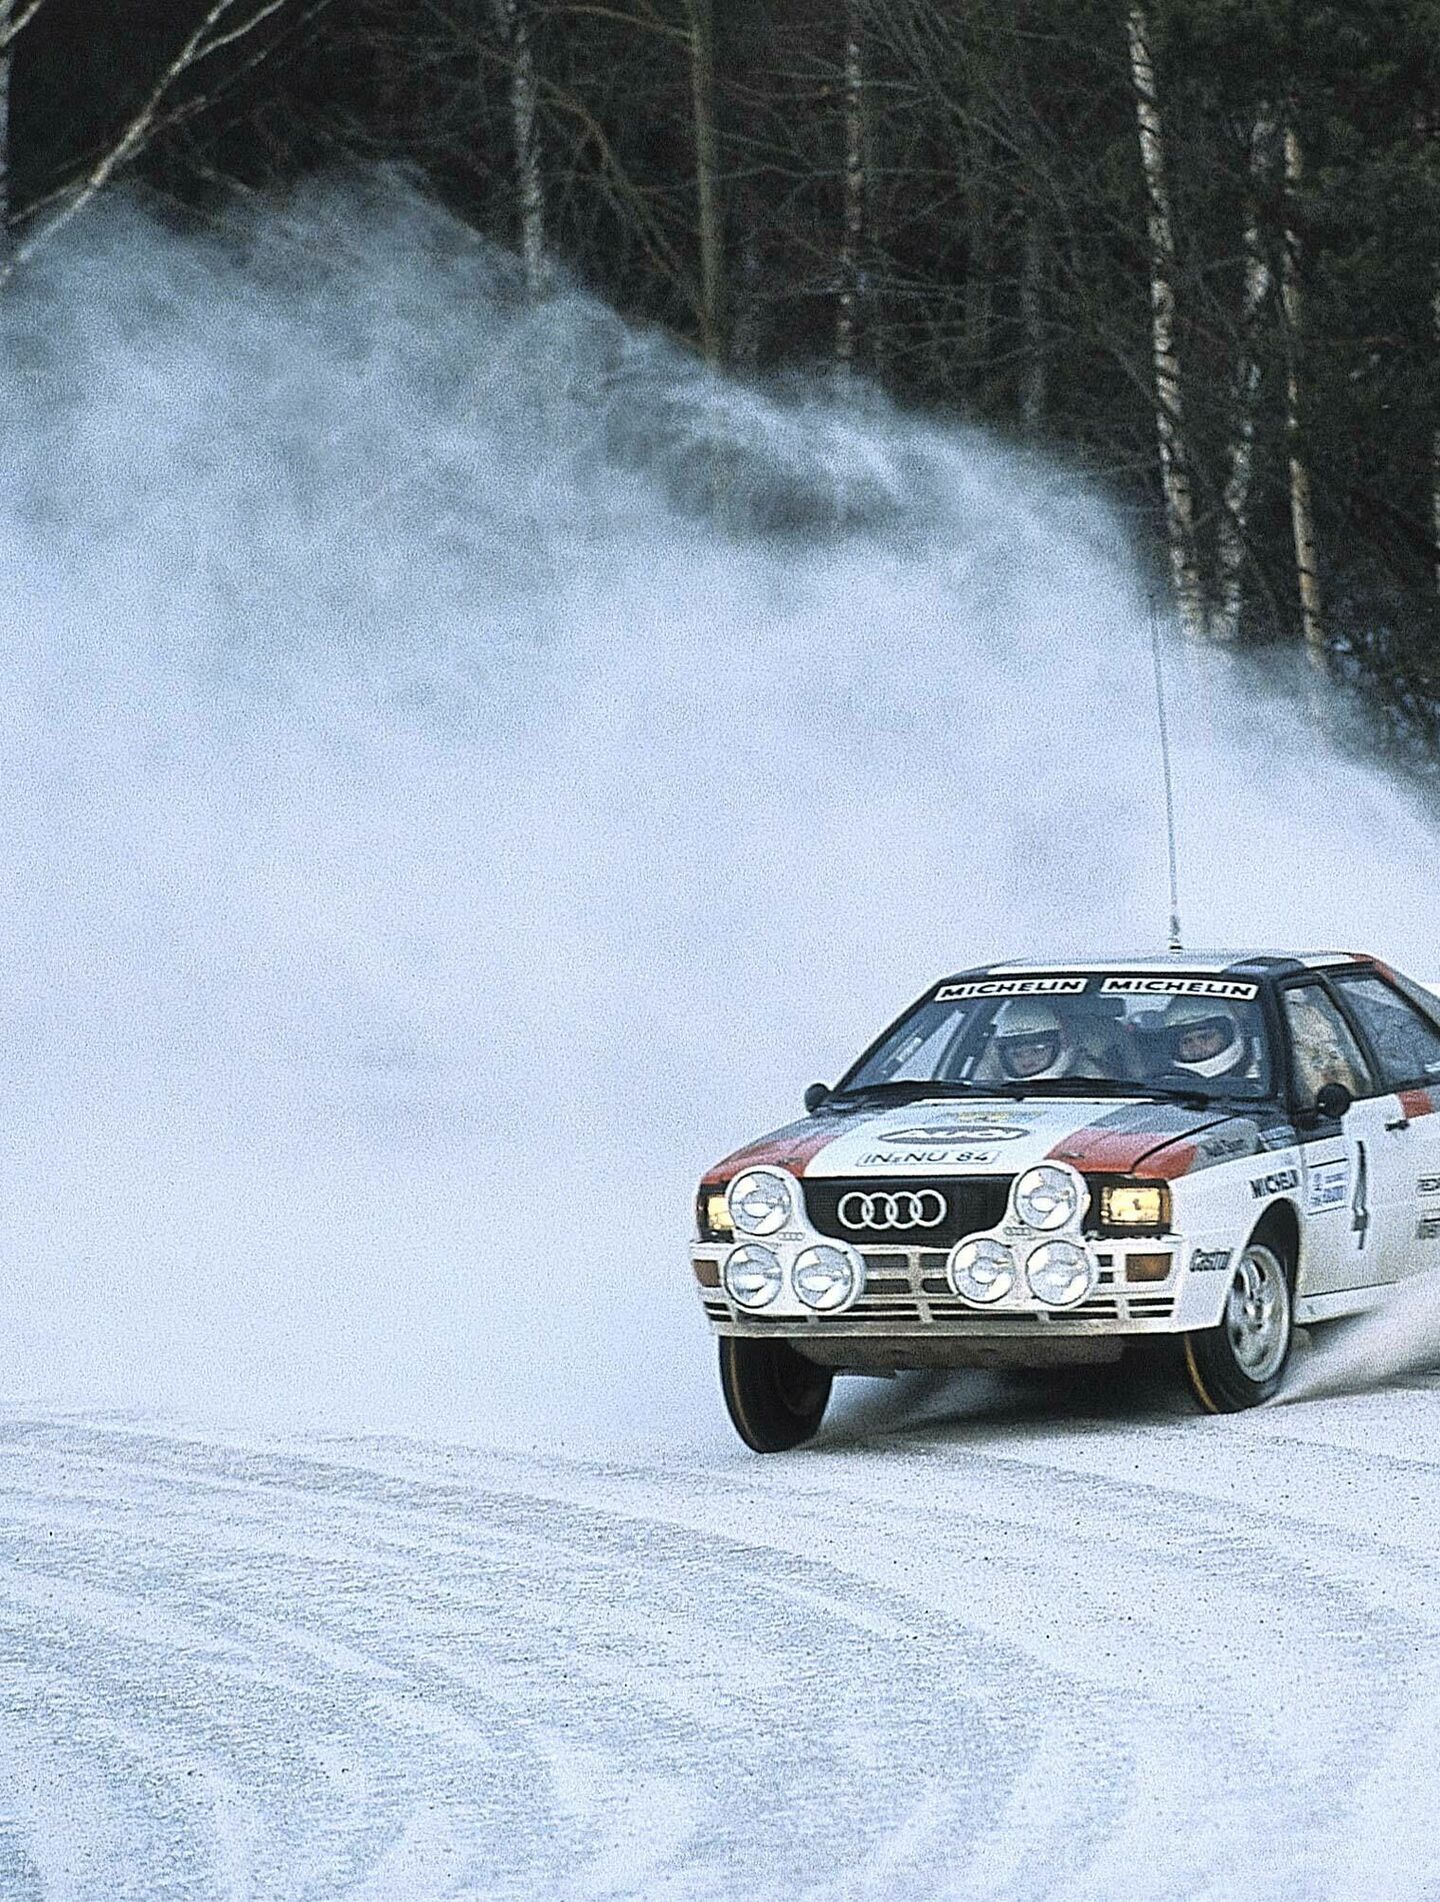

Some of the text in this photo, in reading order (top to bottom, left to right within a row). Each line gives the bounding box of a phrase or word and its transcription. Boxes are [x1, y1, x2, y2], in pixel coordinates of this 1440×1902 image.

[940, 980, 1083, 998] MICHELIN
[1106, 980, 1253, 997] MICHELIN
[956, 1151, 988, 1161] 84
[1249, 1168, 1300, 1200] MICHELIN
